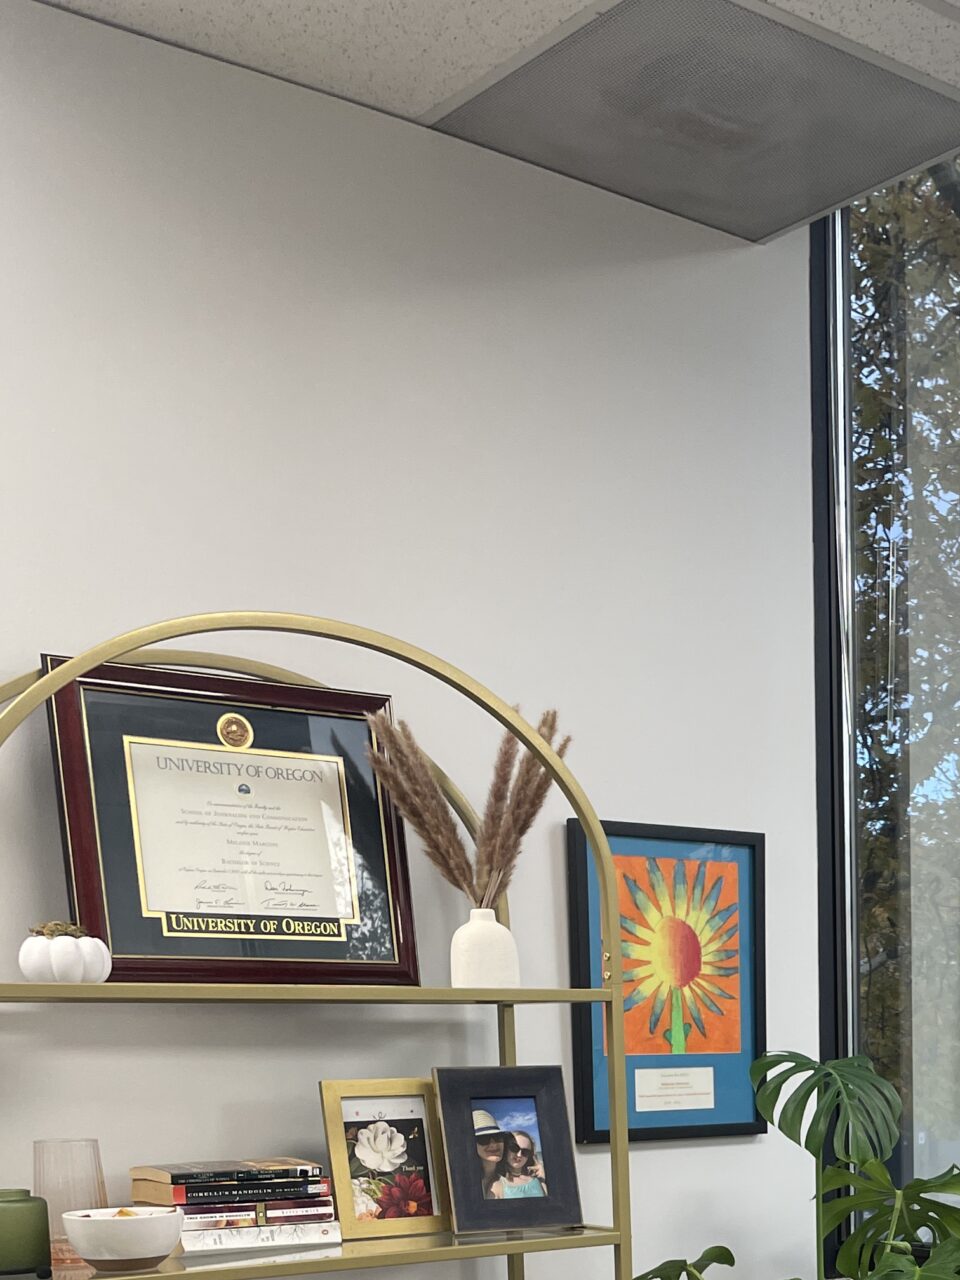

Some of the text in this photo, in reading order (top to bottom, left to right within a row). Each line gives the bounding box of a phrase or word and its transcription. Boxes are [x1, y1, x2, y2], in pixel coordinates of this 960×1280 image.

[156, 756, 323, 783] UNIVERSITY OF OREGON
[169, 914, 339, 935] UNIVERSITY OF OREGON
